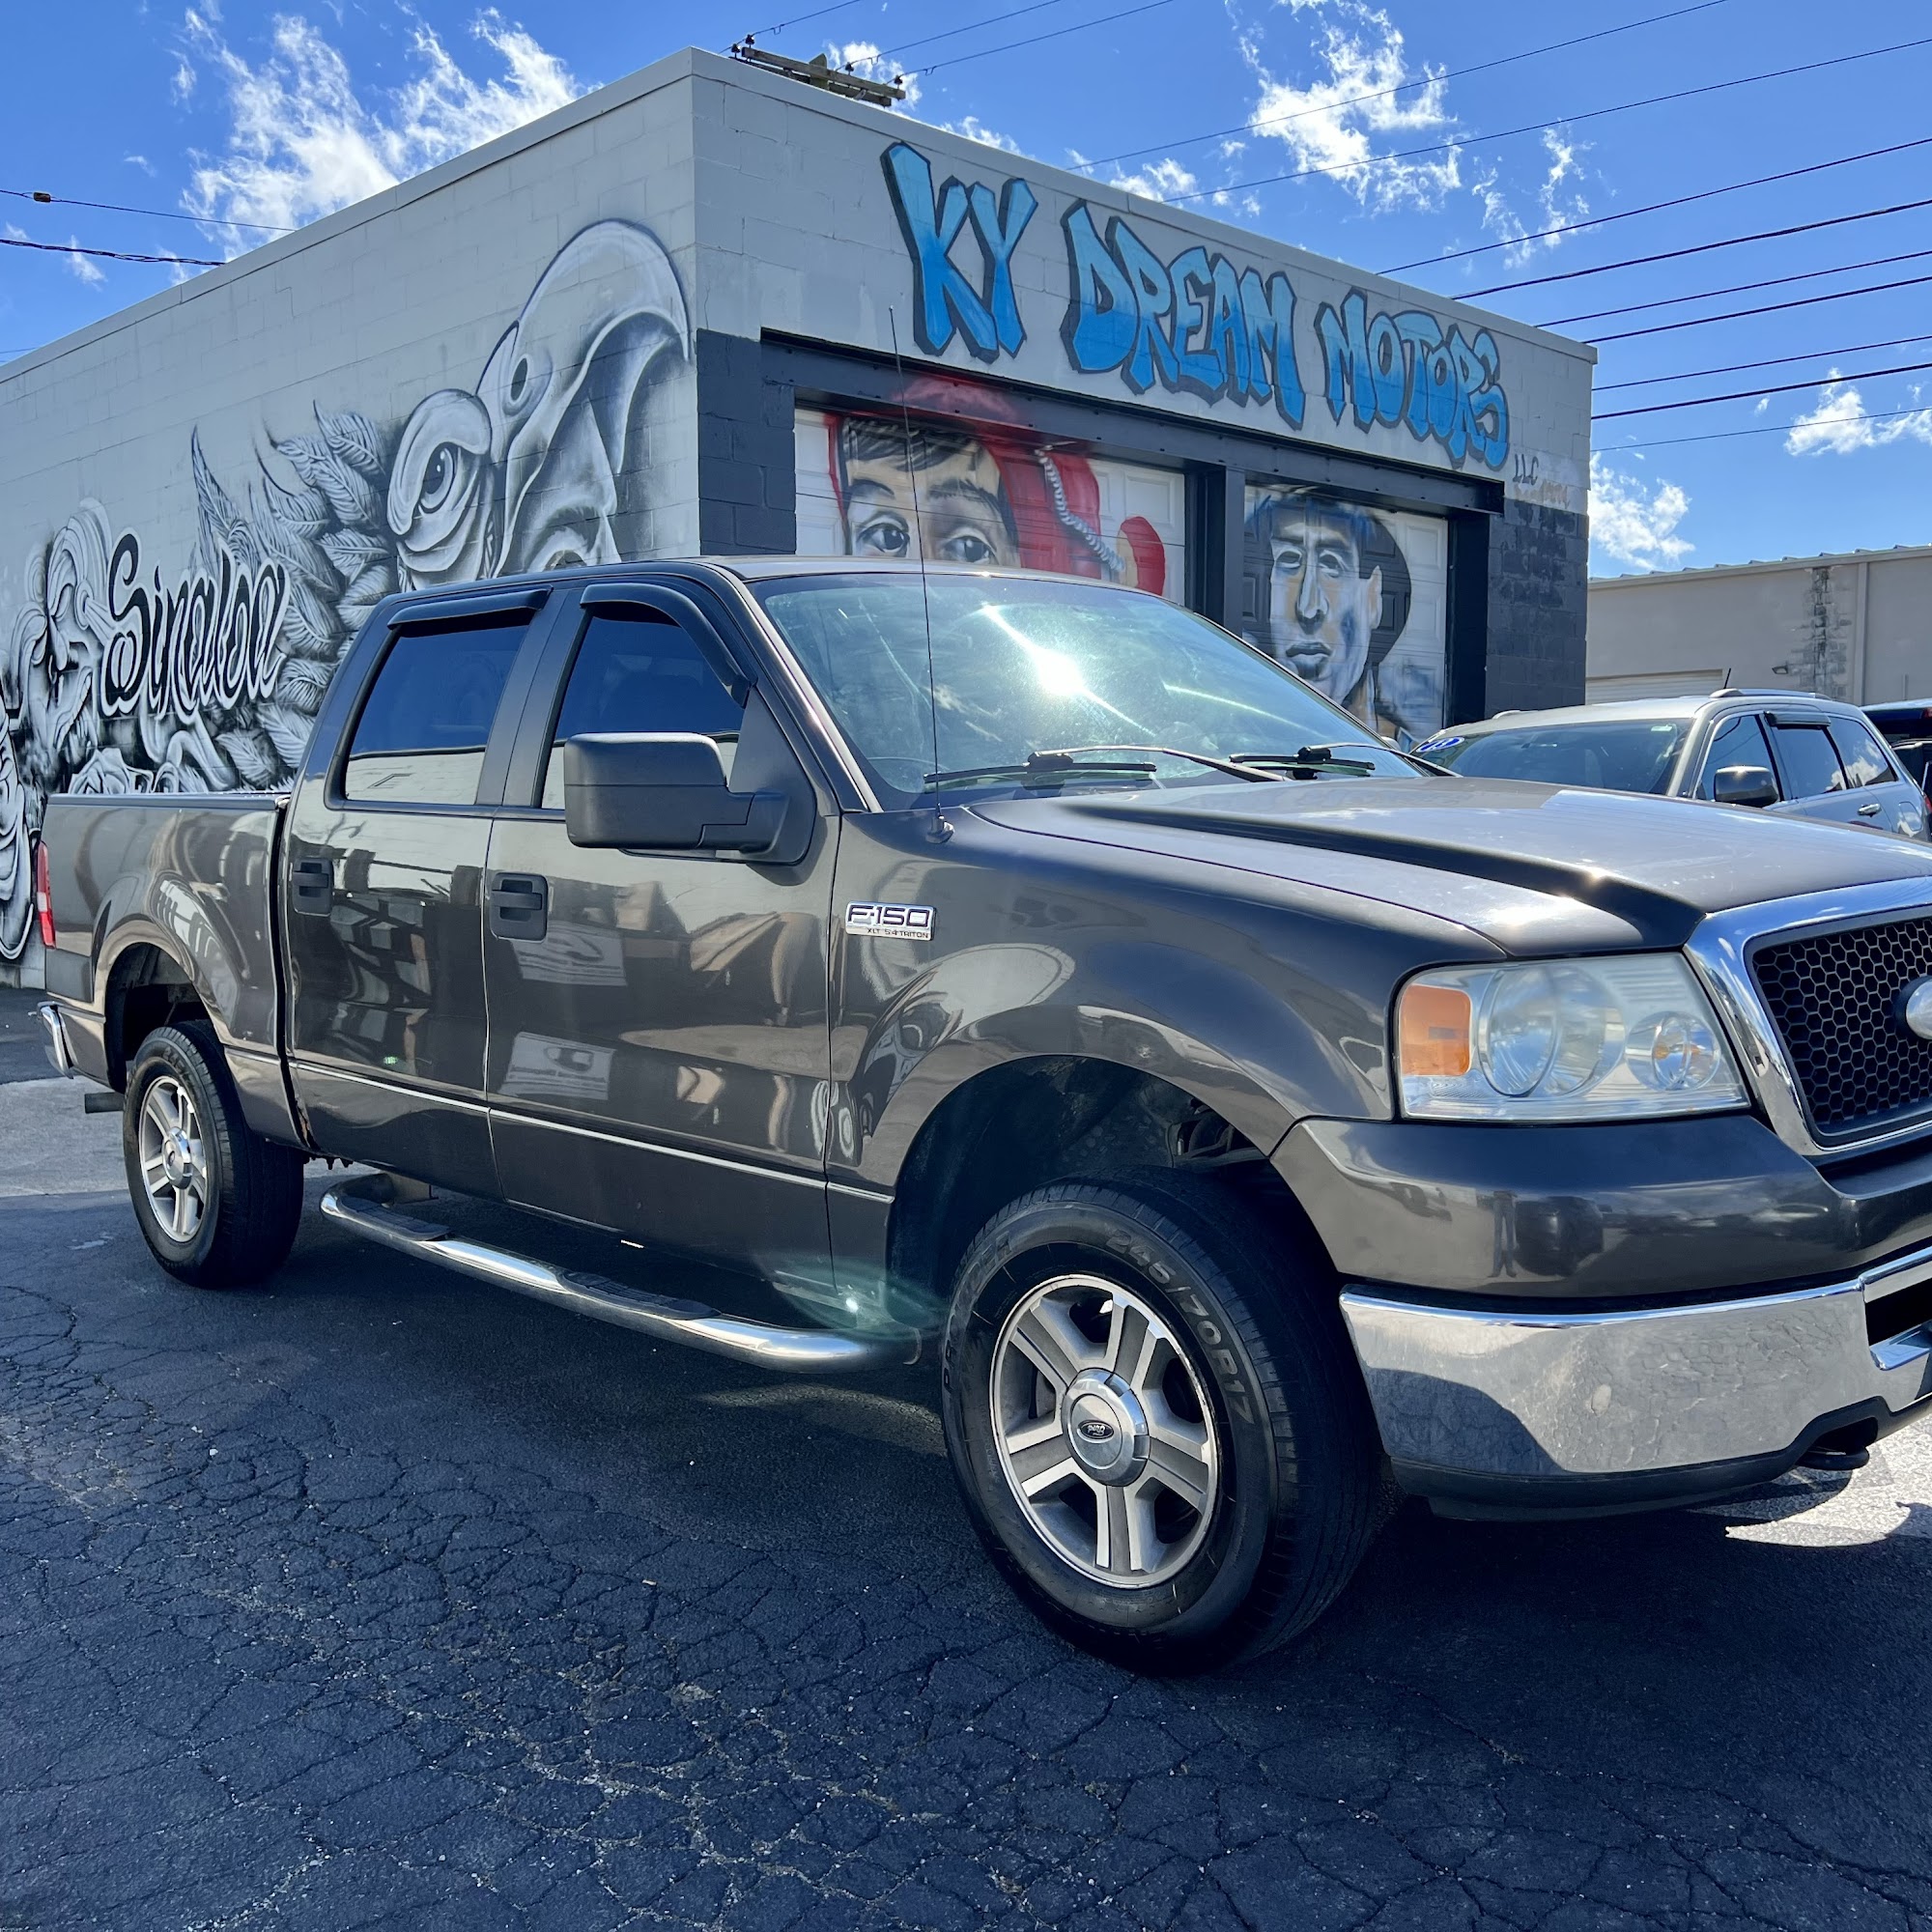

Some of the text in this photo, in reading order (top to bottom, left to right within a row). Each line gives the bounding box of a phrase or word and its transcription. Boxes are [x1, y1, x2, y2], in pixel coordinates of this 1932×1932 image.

[880, 141, 1510, 470] KY DREAM MOTORS
[1512, 453, 1540, 486] LLC
[847, 904, 930, 926] F-150
